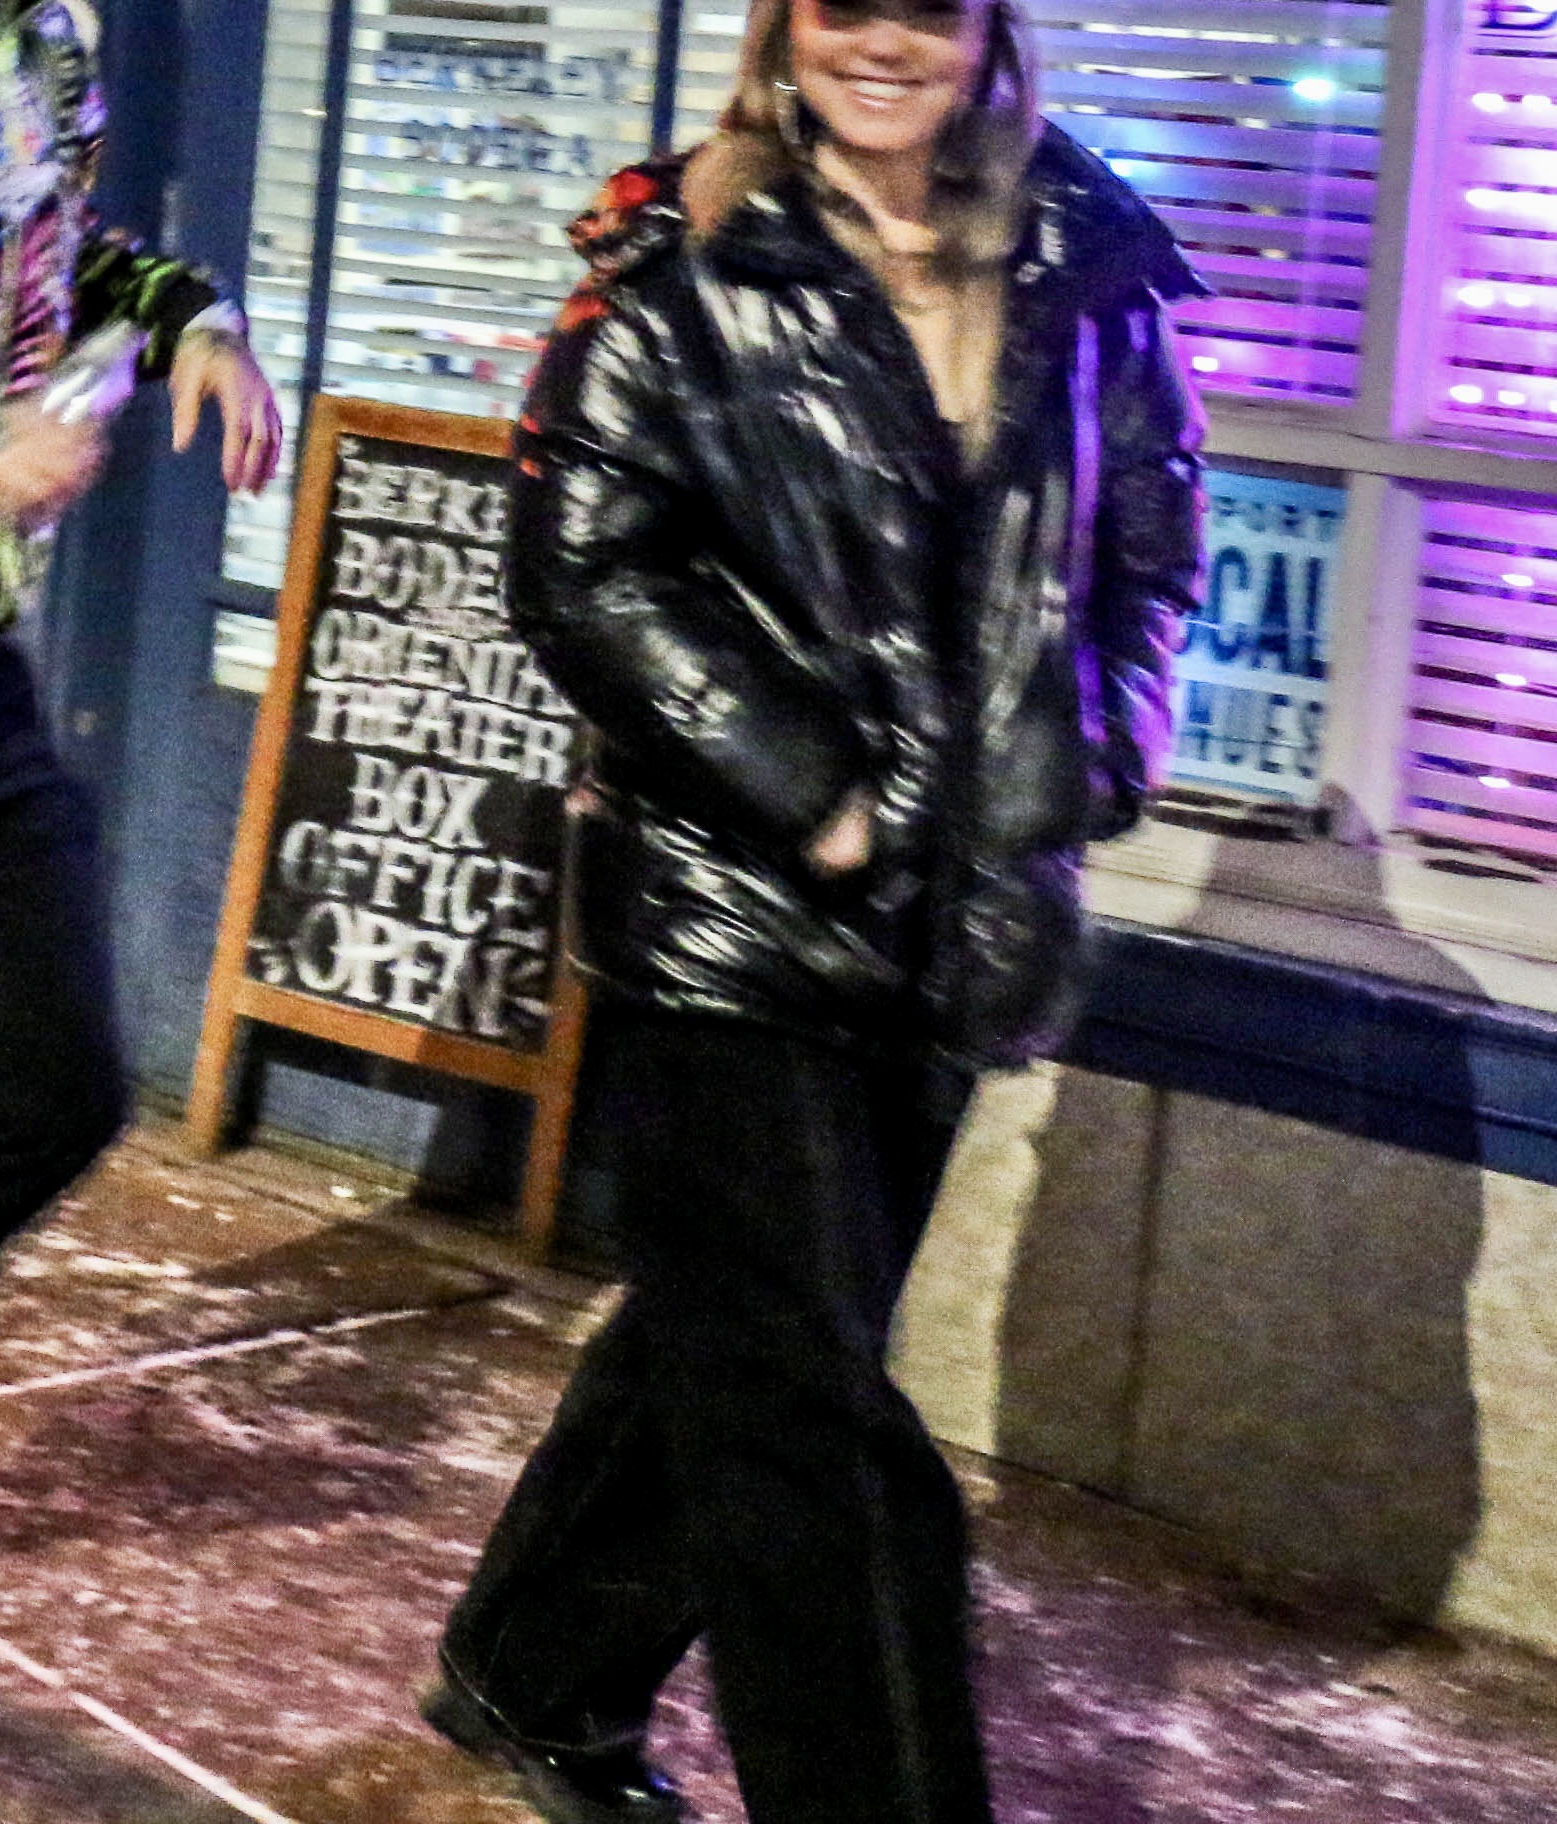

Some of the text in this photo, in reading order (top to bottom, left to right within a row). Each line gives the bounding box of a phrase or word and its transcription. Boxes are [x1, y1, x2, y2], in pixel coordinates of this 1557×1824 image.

[332, 529, 513, 619] BODE
[305, 678, 573, 788] THEATER
[348, 752, 488, 850] BOX
[279, 821, 552, 951] OFFICE
[289, 900, 523, 1038] OPEN
